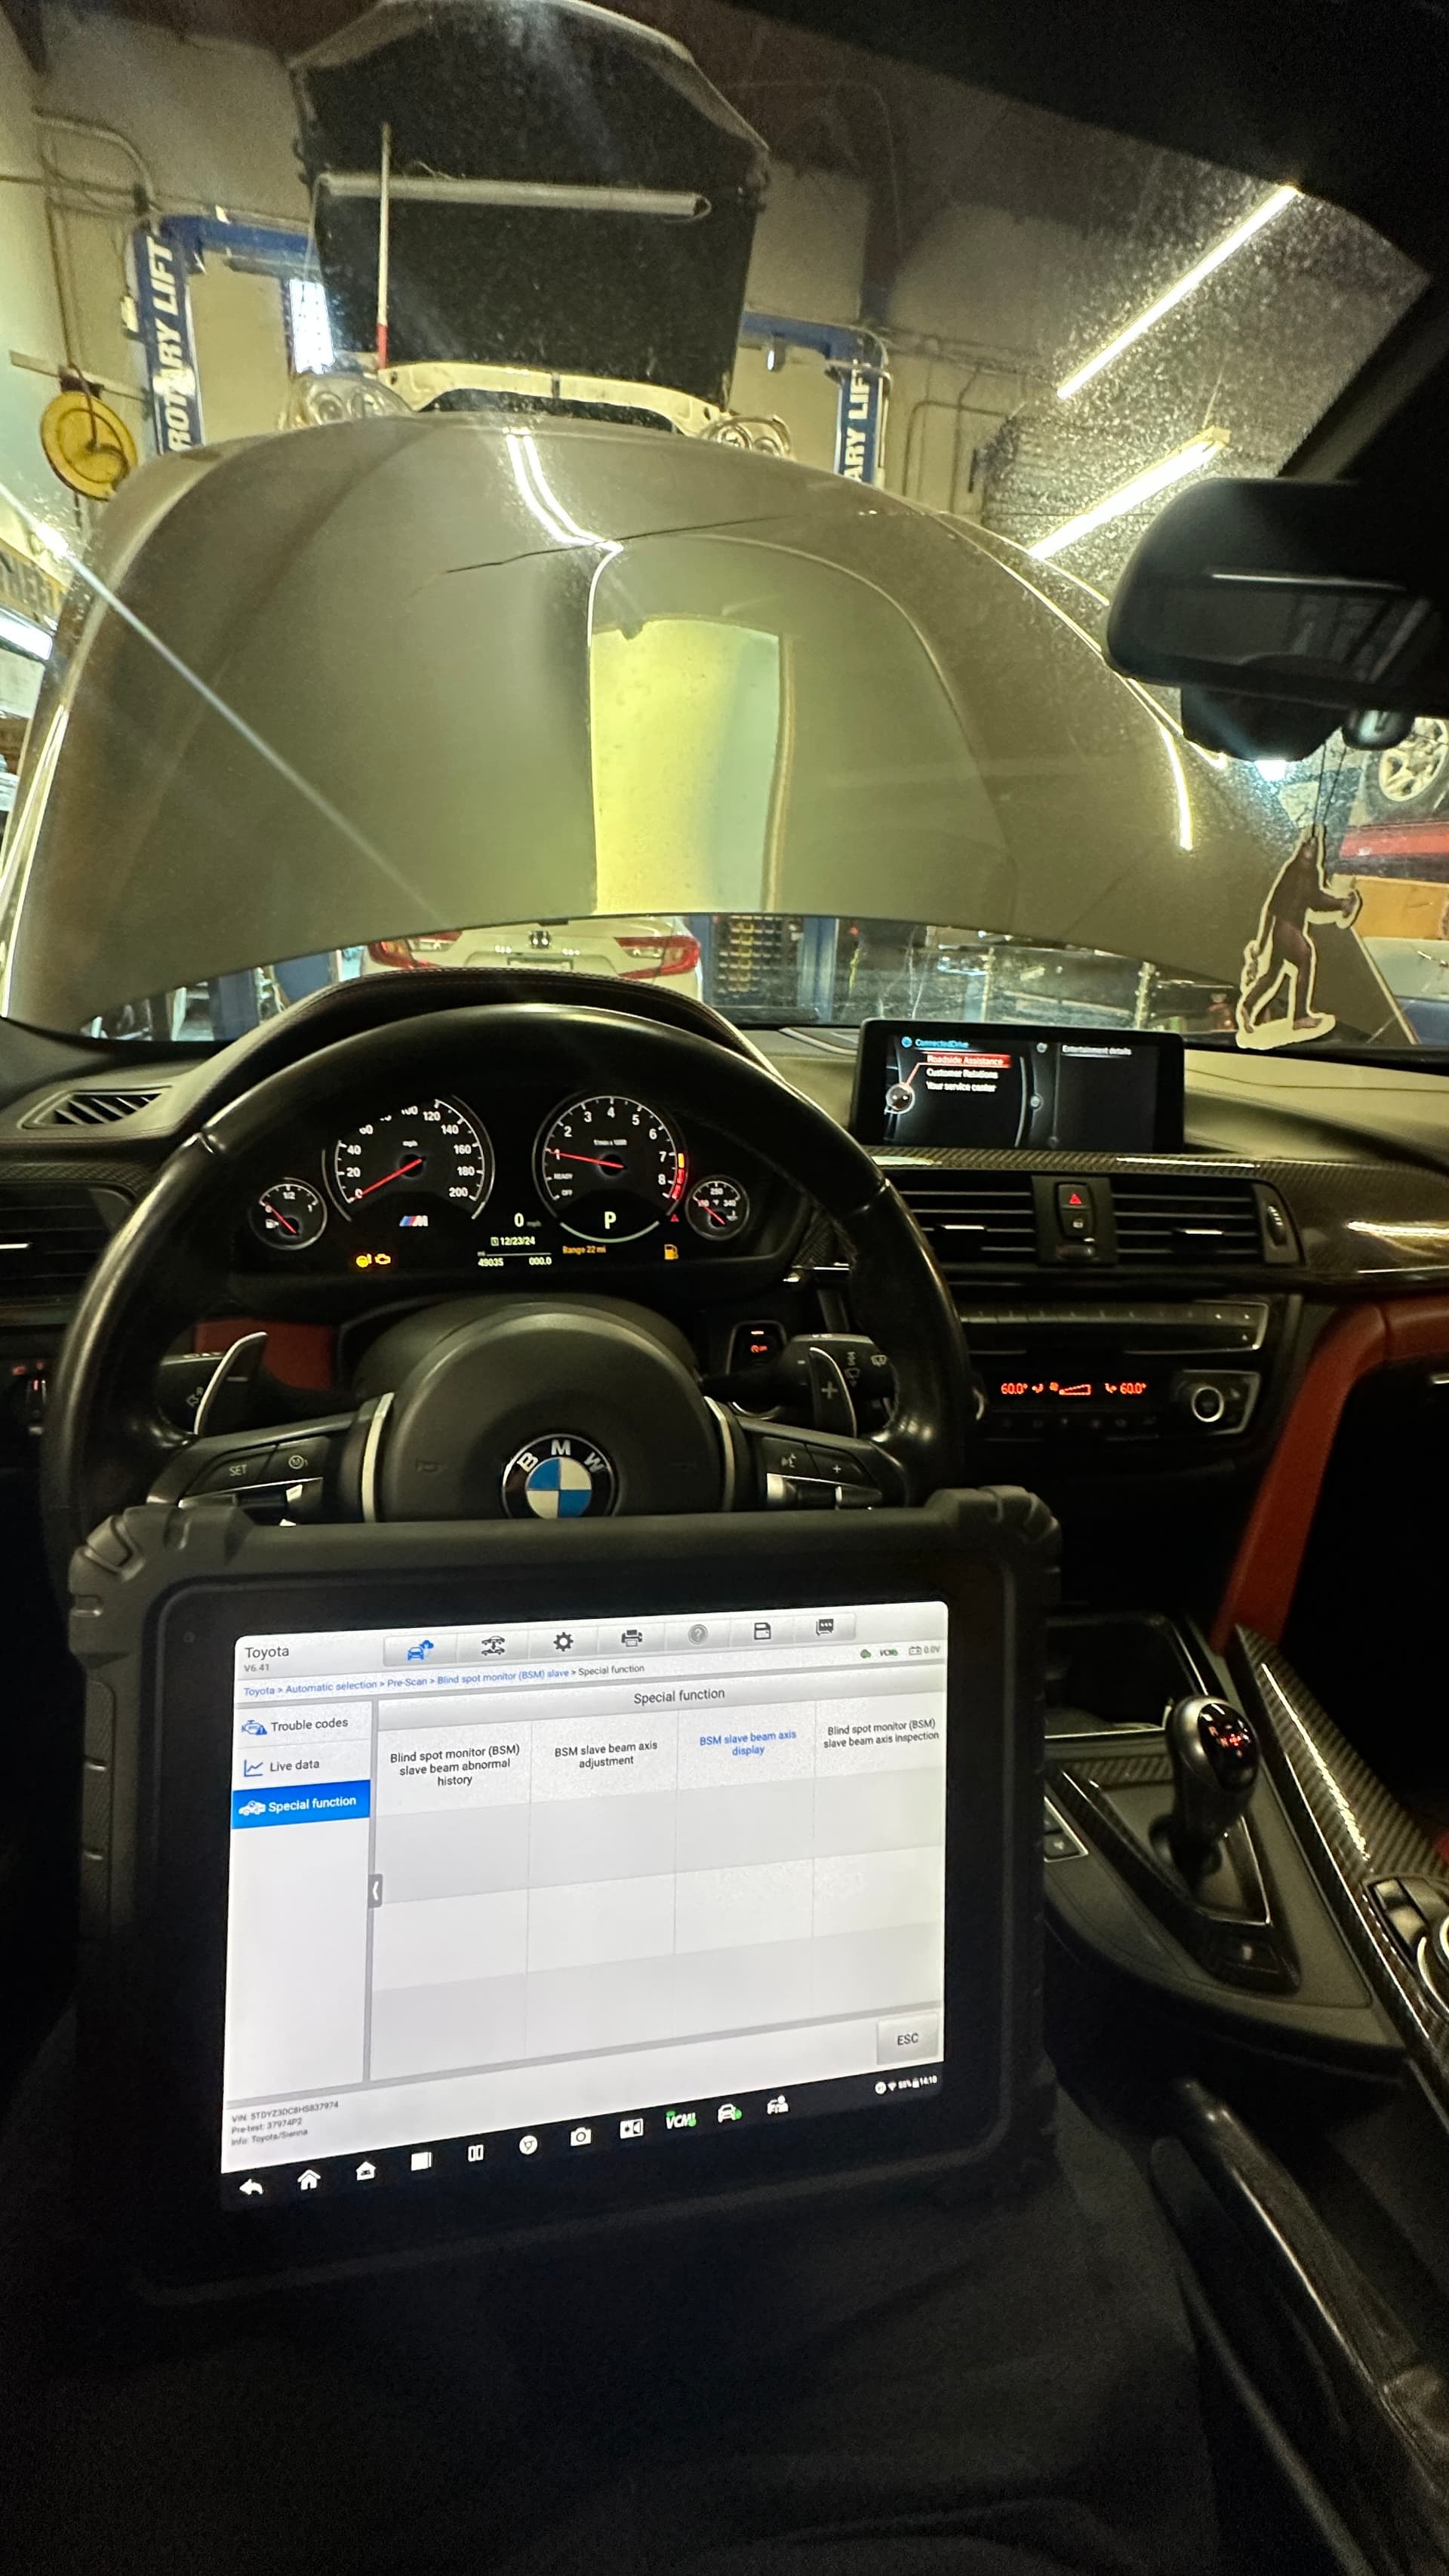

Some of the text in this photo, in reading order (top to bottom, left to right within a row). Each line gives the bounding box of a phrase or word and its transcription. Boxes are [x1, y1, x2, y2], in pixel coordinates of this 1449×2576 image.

[146, 235, 179, 316] LIFT
[848, 359, 870, 420] LIF
[927, 1054, 1004, 1066] Roadside Assistance
[926, 1067, 962, 1078] Customer
[926, 1081, 997, 1092] Your service center
[423, 1111, 441, 1122] 120
[583, 1111, 592, 1122] 3
[607, 1106, 615, 1118] 4
[632, 1114, 640, 1125] 5
[441, 1125, 460, 1134] 140
[564, 1125, 573, 1137] 2
[649, 1128, 657, 1140] 6
[346, 1144, 361, 1155] 40
[454, 1144, 472, 1154] 160
[555, 1149, 561, 1159] 1
[658, 1151, 667, 1162] 7
[346, 1167, 361, 1177] 20
[457, 1166, 475, 1176] 180
[658, 1174, 666, 1185] 8
[355, 1188, 363, 1199] 0
[448, 1186, 469, 1197] 200
[514, 1212, 525, 1227] 0
[604, 1211, 617, 1230] P
[500, 1236, 536, 1246] 12/23/24
[562, 1245, 586, 1255] Range
[586, 1245, 596, 1254] 22
[528, 1256, 552, 1266] 000.0
[516, 1439, 605, 1473] BMW
[229, 1464, 248, 1476] SET
[245, 1646, 290, 1660] Toyota
[244, 1663, 270, 1673] V6.41
[244, 1687, 275, 1697] Toyota
[285, 1684, 333, 1694] Automatic
[336, 1680, 377, 1691] selection
[387, 1677, 427, 1687] Pre-Scan
[437, 1674, 459, 1685] Blind
[461, 1673, 481, 1685] spot
[483, 1672, 516, 1681] monitor
[518, 1670, 545, 1681] (BSM)
[547, 1668, 569, 1678] slave
[578, 1666, 609, 1677] Special
[611, 1664, 645, 1674] function
[633, 1688, 725, 1706] Special function
[271, 1718, 349, 1732] Trouble codes
[827, 1718, 936, 1736] Blind spot monitor (BSM)
[700, 1729, 797, 1746] BSM slave beam axis
[823, 1731, 940, 1749] slave beam axis inspection
[390, 1743, 520, 1763] Blind spot monitor (BSM)
[555, 1740, 658, 1757] BSM slave beam axis
[732, 1745, 765, 1756] display
[269, 1759, 320, 1772] Live data
[399, 1758, 511, 1776] slave beam abnormal
[579, 1755, 635, 1770] adjustment
[437, 1776, 473, 1787] history
[268, 1796, 357, 1814] Special function
[897, 2033, 918, 2046] ESC
[232, 2117, 303, 2134] Pre-test: 37974P2
[231, 2128, 309, 2147] Info: Toyota/Sienna
